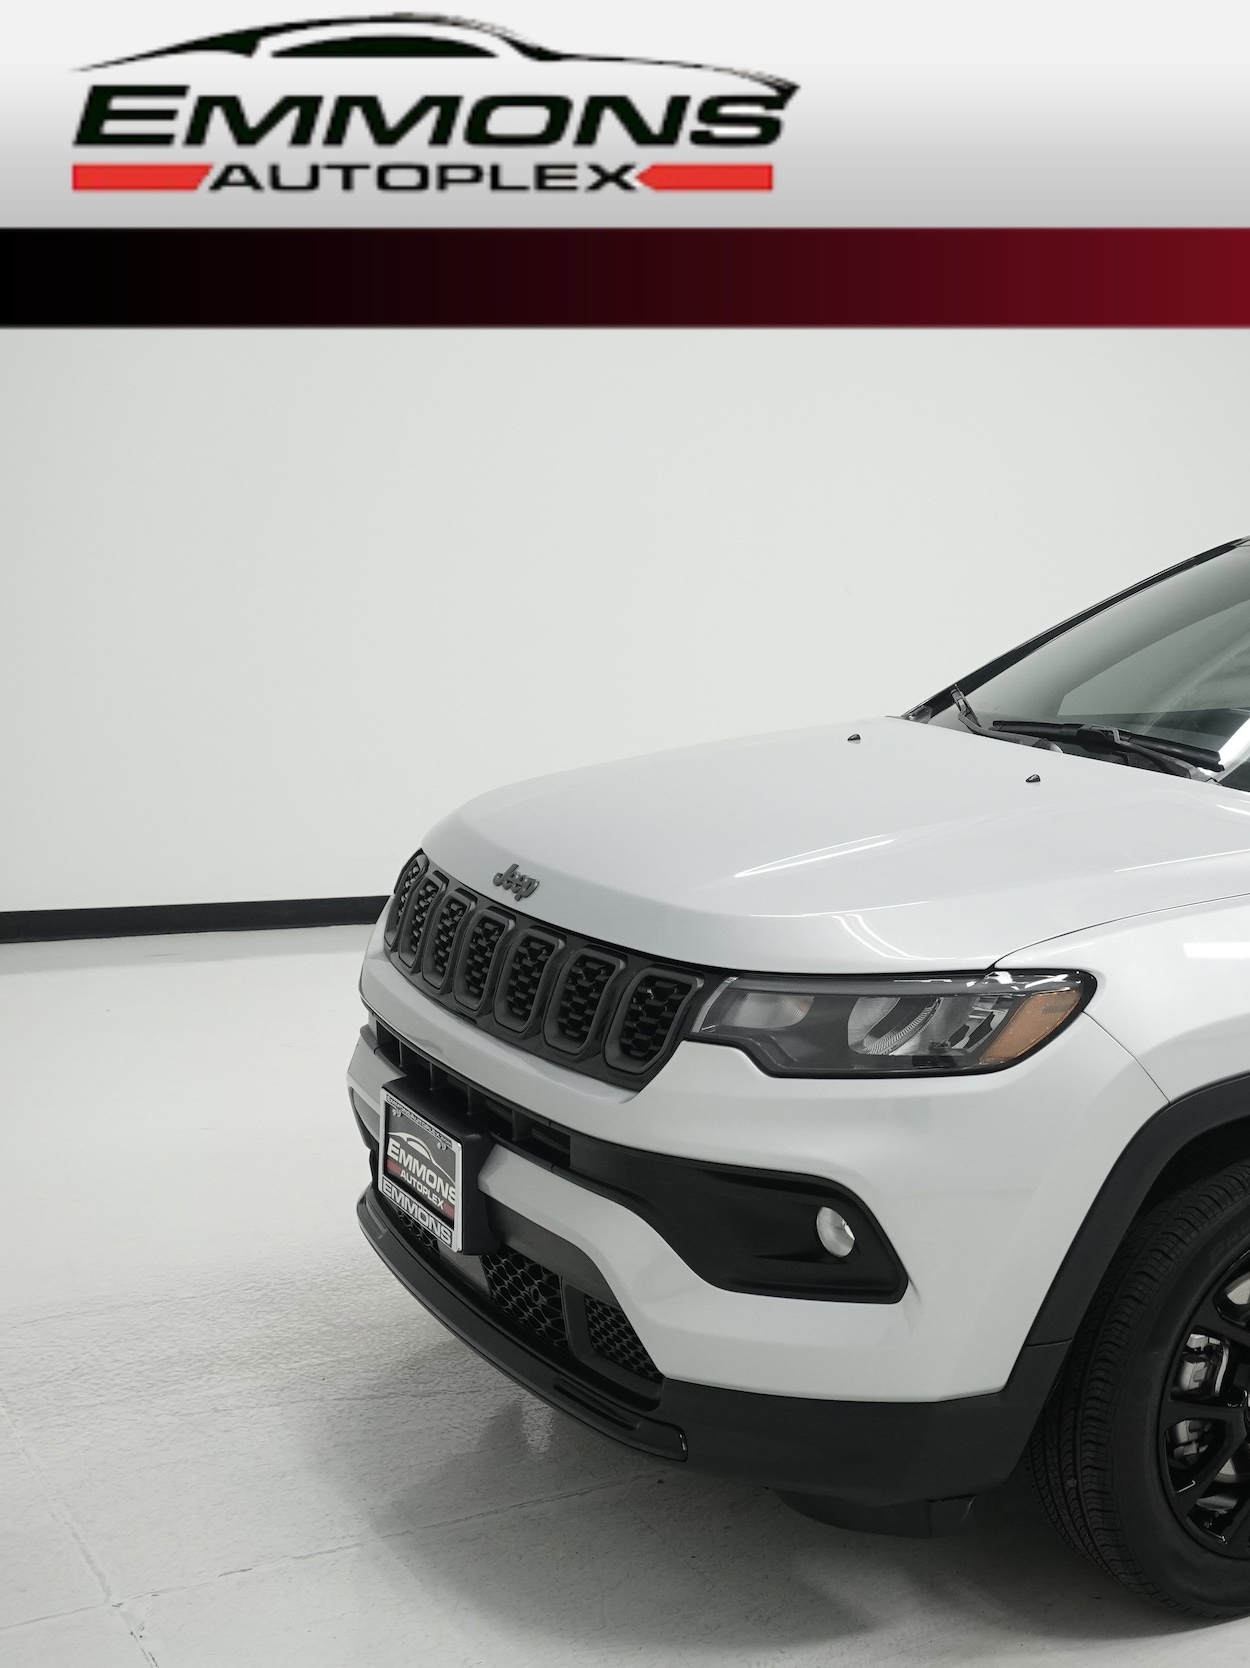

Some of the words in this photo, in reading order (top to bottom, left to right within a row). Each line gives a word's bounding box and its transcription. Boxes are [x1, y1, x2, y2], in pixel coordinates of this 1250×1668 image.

[493, 863, 540, 901] Jeep
[387, 1137, 456, 1206] EMMONS
[400, 1168, 445, 1211] AUTOPLEX
[383, 1178, 452, 1246] EMMONS
